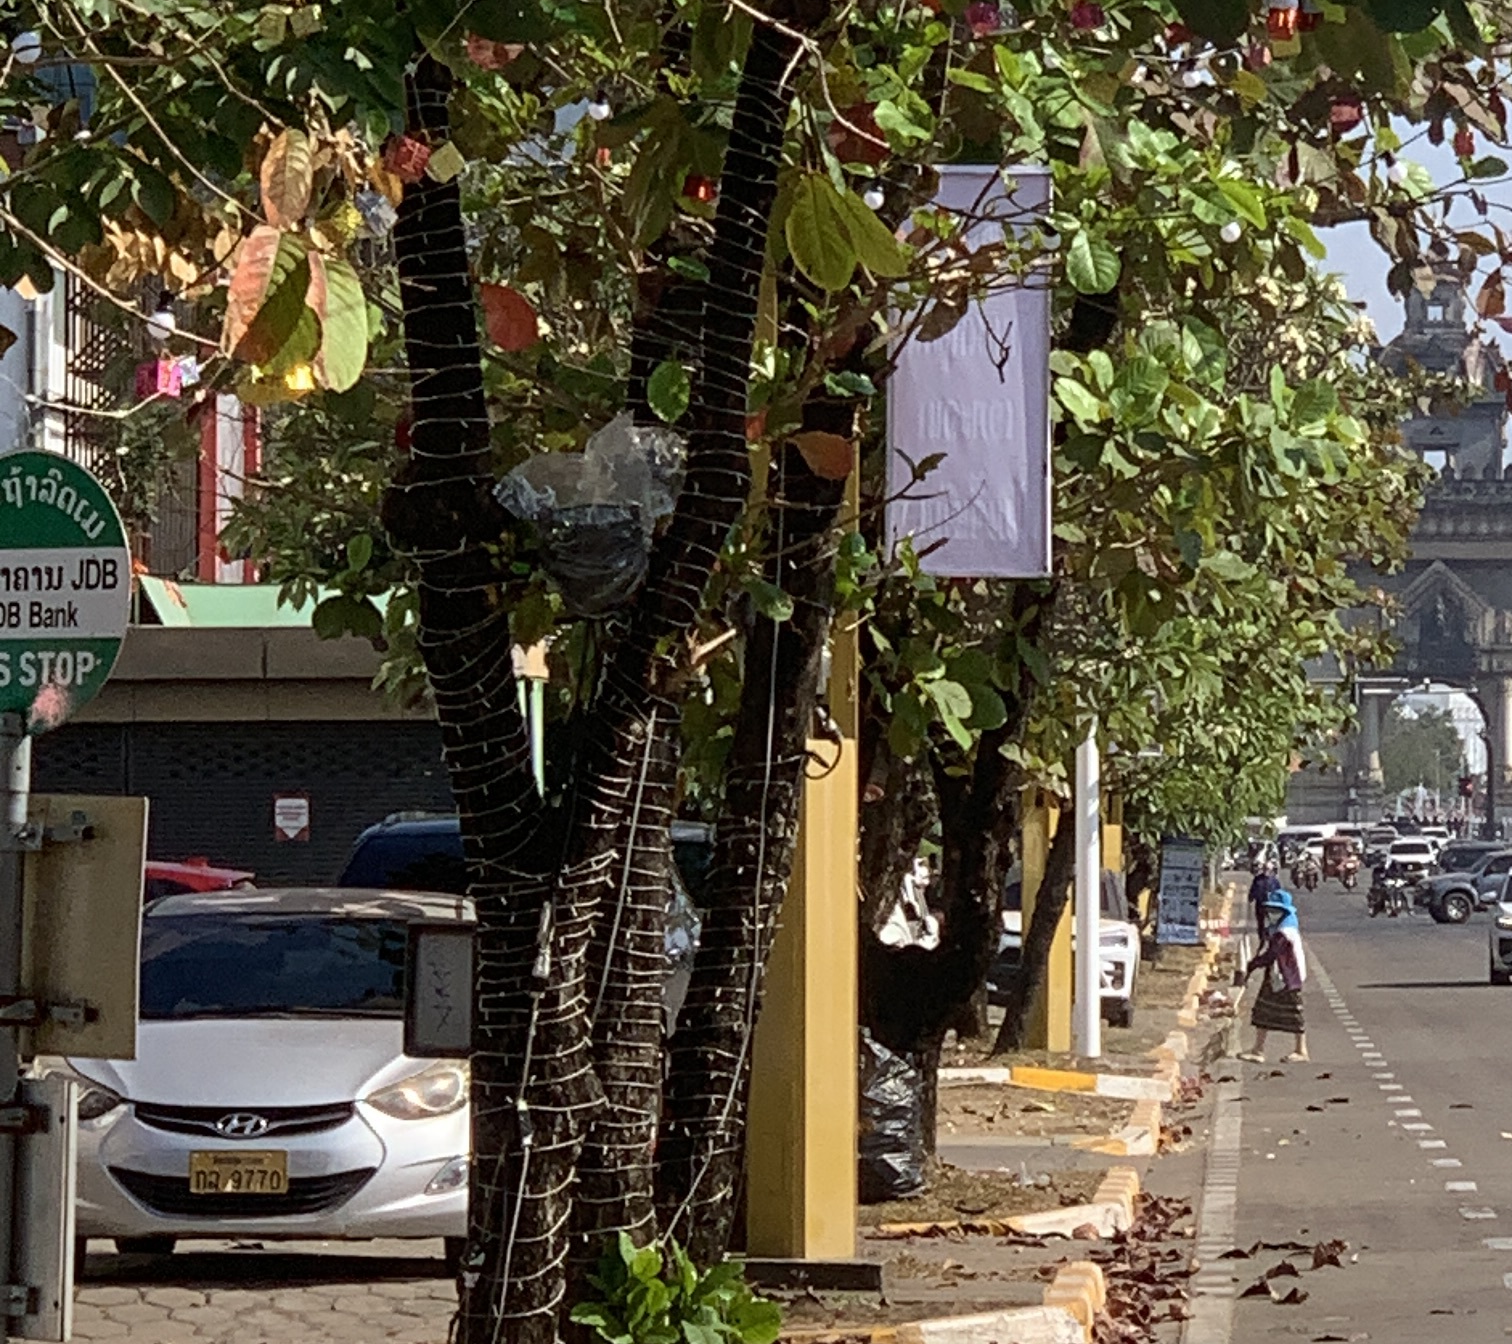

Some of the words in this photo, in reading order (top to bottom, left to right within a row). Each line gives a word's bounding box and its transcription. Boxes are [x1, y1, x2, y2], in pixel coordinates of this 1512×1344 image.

[70, 558, 118, 590] JDB
[29, 600, 79, 628] Bank
[19, 650, 95, 687] STOP
